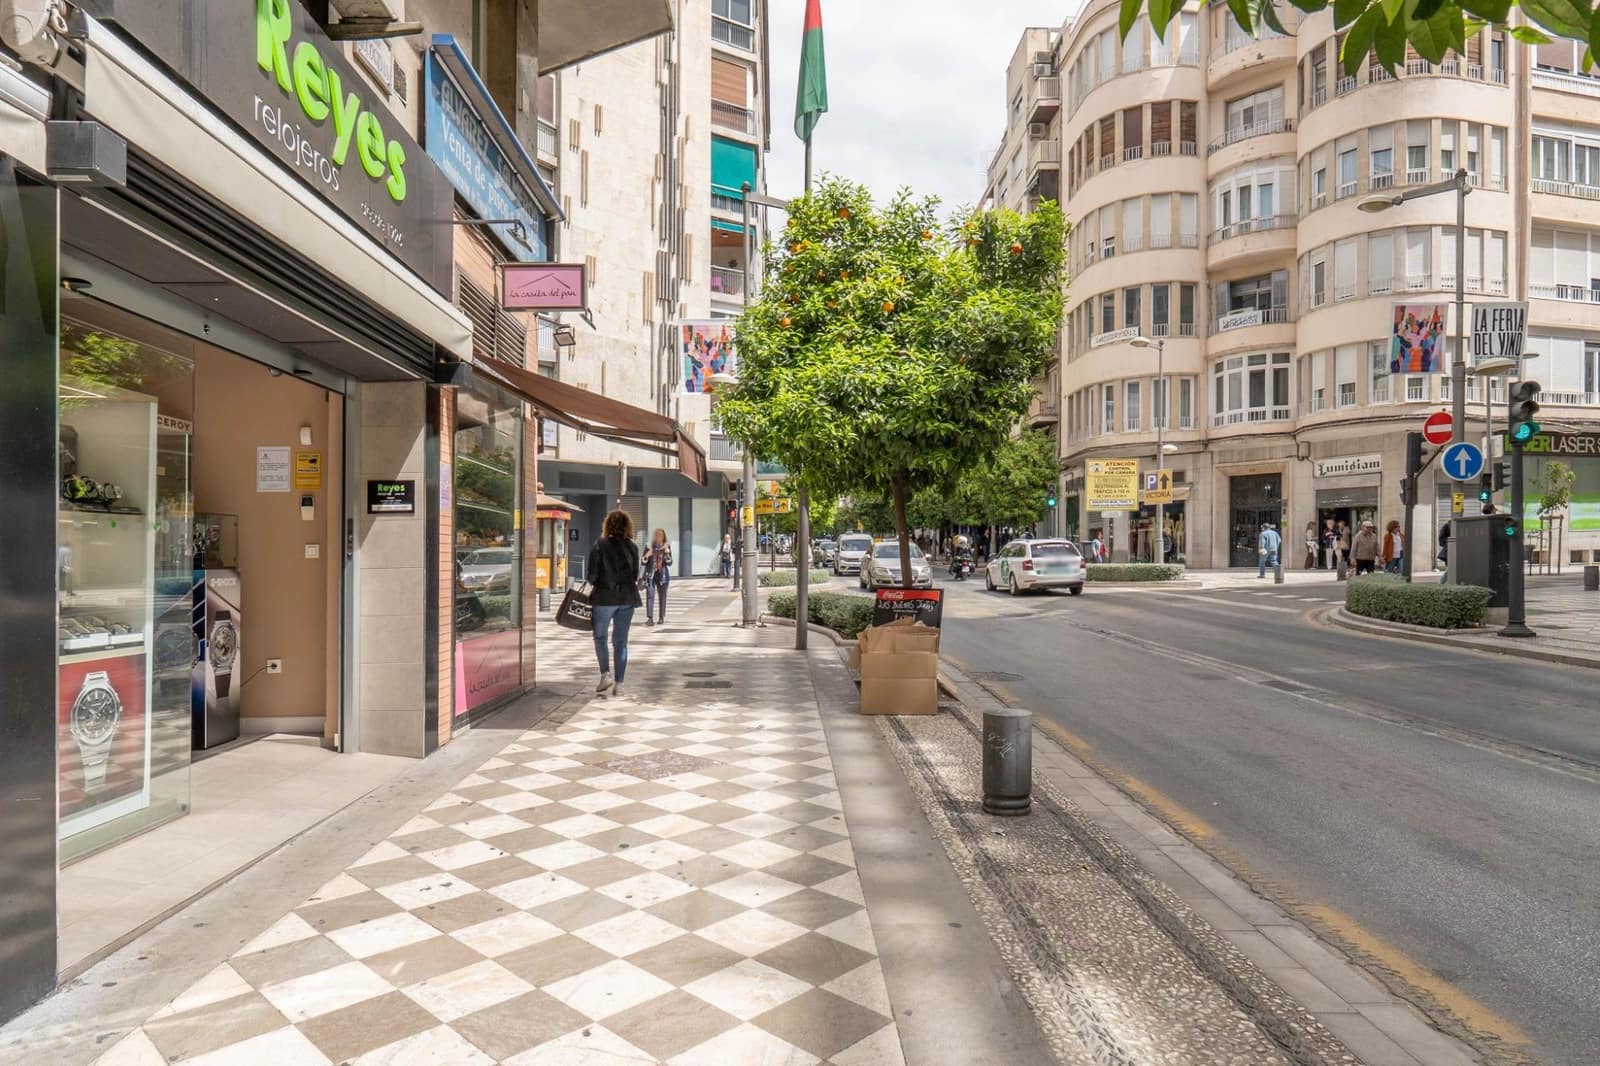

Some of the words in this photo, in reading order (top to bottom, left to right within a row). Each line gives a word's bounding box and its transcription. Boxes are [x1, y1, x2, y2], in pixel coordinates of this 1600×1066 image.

[257, 0, 406, 201] Reyes
[254, 95, 340, 191] relojeros
[441, 112, 472, 176] Venta
[474, 161, 486, 191] de
[548, 287, 560, 297] del
[560, 290, 577, 300] pan
[1474, 308, 1488, 332] LA
[1492, 308, 1524, 332] FERIA
[1474, 332, 1495, 355] DEL
[1498, 332, 1523, 356] VINO
[1551, 436, 1596, 453] LASER
[377, 483, 406, 494] Reyes
[1147, 475, 1157, 489] P
[1146, 490, 1171, 499] VICTORIA
